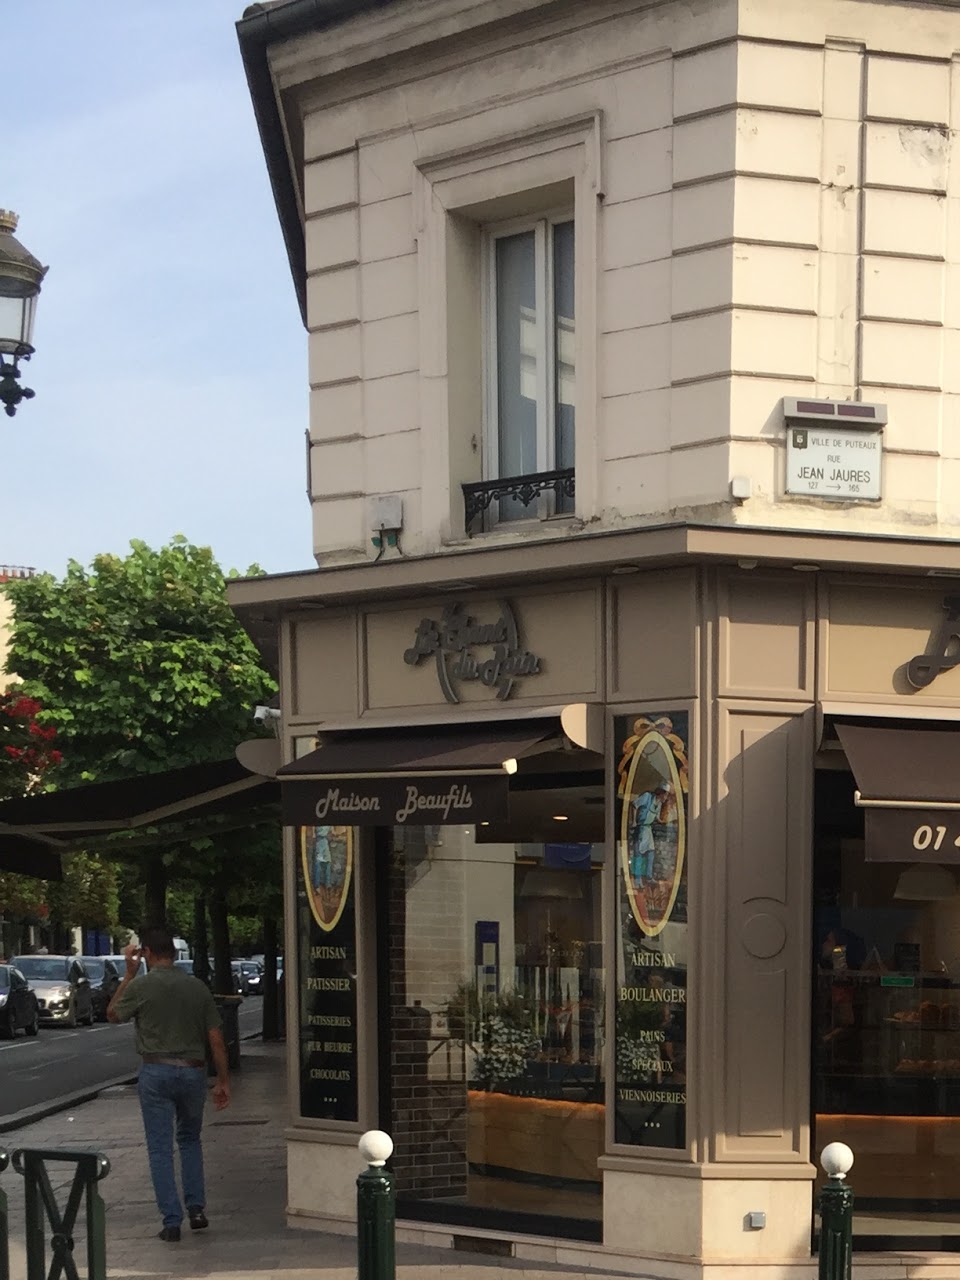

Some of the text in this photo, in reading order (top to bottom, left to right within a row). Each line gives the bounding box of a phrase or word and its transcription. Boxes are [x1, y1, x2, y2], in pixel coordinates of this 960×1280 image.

[811, 438, 830, 447] VILLE
[845, 440, 876, 450] PUTEAUX
[827, 455, 841, 463] RUE
[797, 467, 871, 483] JEAN JAURES
[849, 484, 860, 493] 165
[316, 784, 473, 823] Maison Beaufils
[913, 825, 947, 850] 01
[310, 946, 347, 960] ARTISAN
[631, 953, 676, 967] ARTISAN
[307, 977, 351, 991] PATISSIER
[620, 987, 686, 1003] BOULANGER
[640, 1029, 666, 1043] PAINS
[307, 1041, 352, 1053] PUR BEURRE
[310, 1068, 351, 1081] CHOCOLATS
[619, 1088, 687, 1105] VIENNOISERIES
